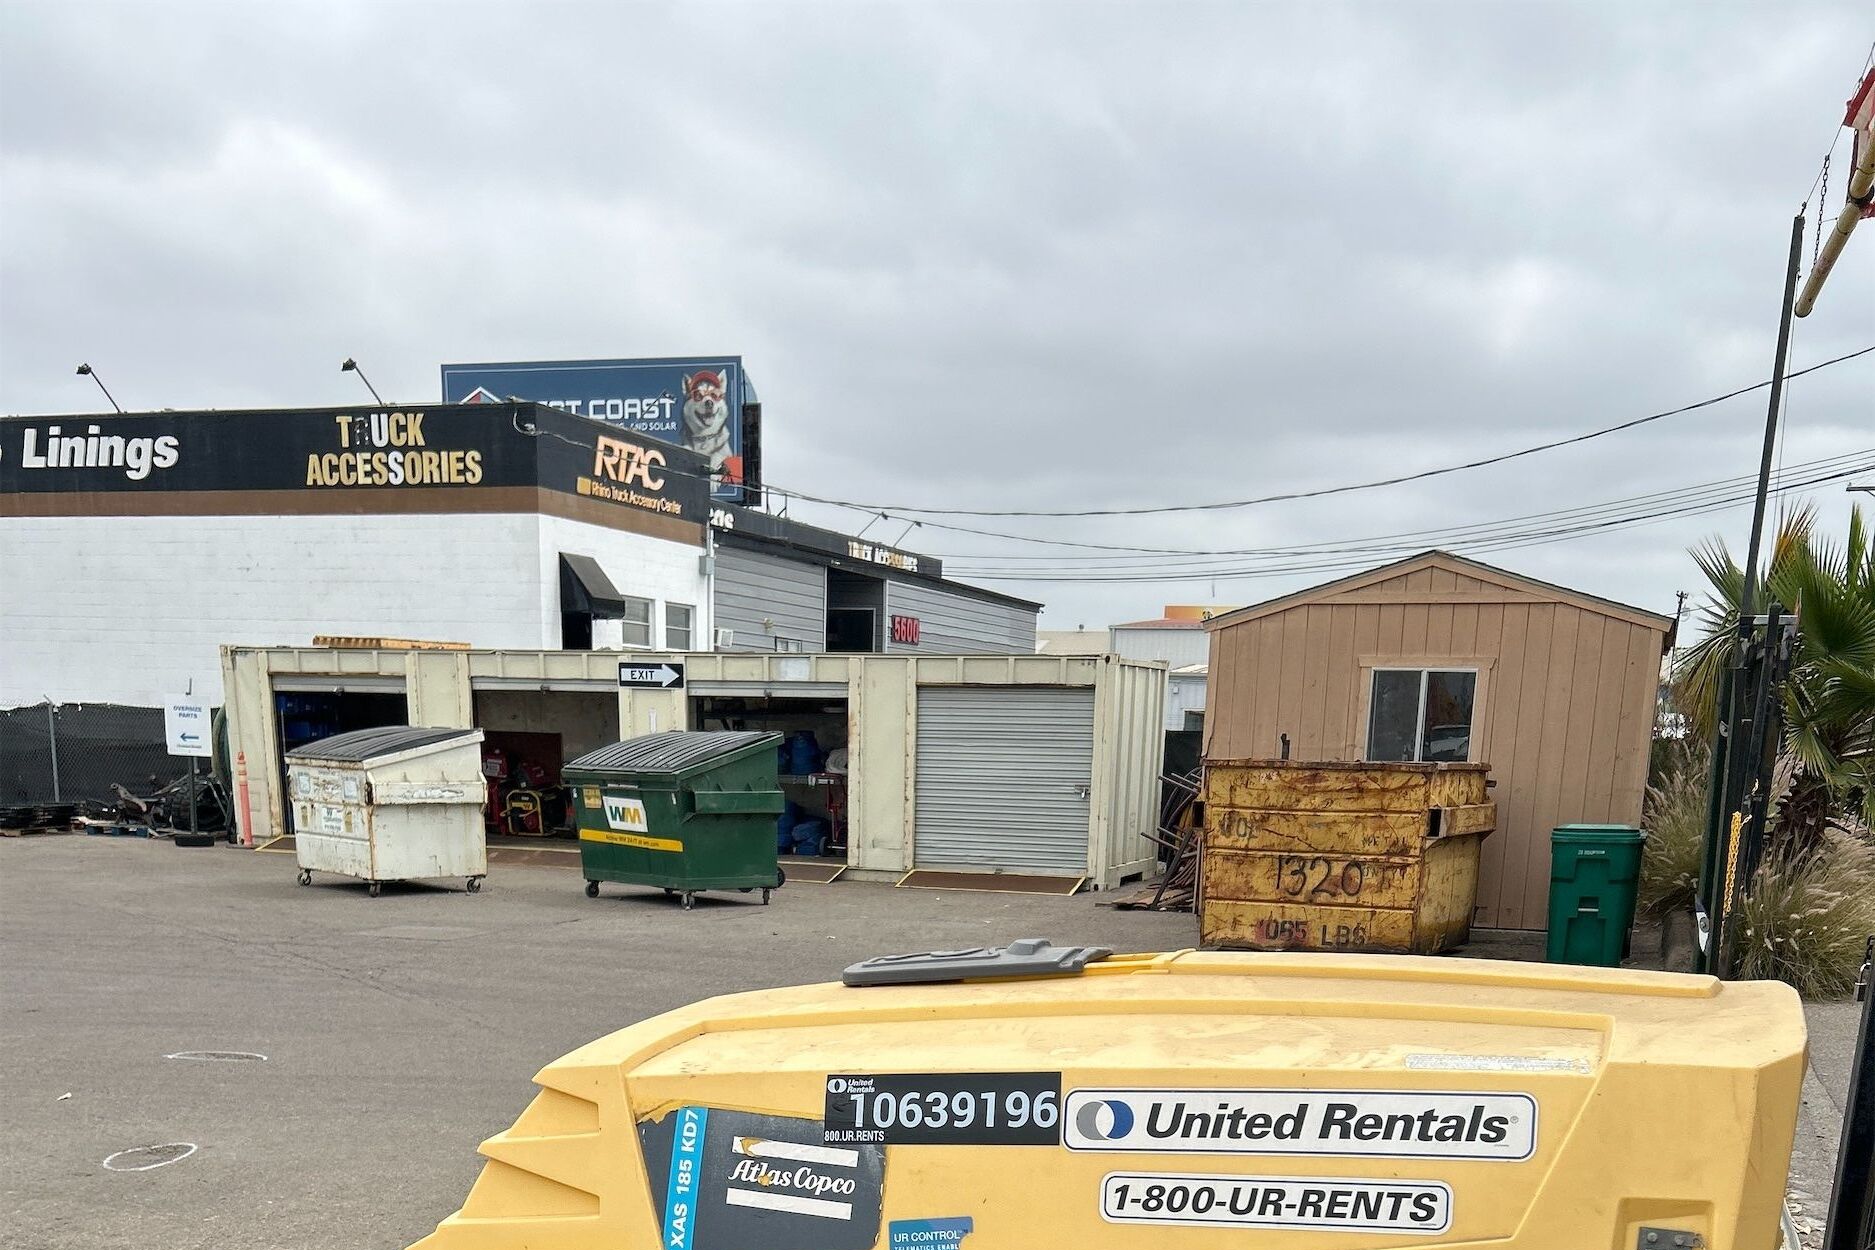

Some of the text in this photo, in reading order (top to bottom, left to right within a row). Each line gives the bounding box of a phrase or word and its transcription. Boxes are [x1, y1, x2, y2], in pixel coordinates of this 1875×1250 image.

[588, 399, 677, 421] COAST
[648, 421, 677, 432] SOLAR
[22, 424, 180, 480] Linings
[594, 435, 667, 491] RTAC
[306, 450, 483, 486] ACCESSORIES
[894, 616, 919, 643] 5600
[630, 670, 655, 680] EXIT
[609, 805, 642, 824] WM
[1276, 854, 1363, 897] 1320
[848, 1079, 874, 1087] United
[850, 1089, 1059, 1128] 10639196
[1146, 1102, 1309, 1141] United
[824, 1130, 886, 1142] 800.UR.RENTS
[670, 1110, 700, 1249] XAS 185 KD7
[727, 1159, 856, 1196] Atlas Copco
[1113, 1184, 1438, 1222] 1-800-UR-RENTS
[893, 1230, 961, 1243] UR CONTROL
[937, 1243, 961, 1250] ENABL
